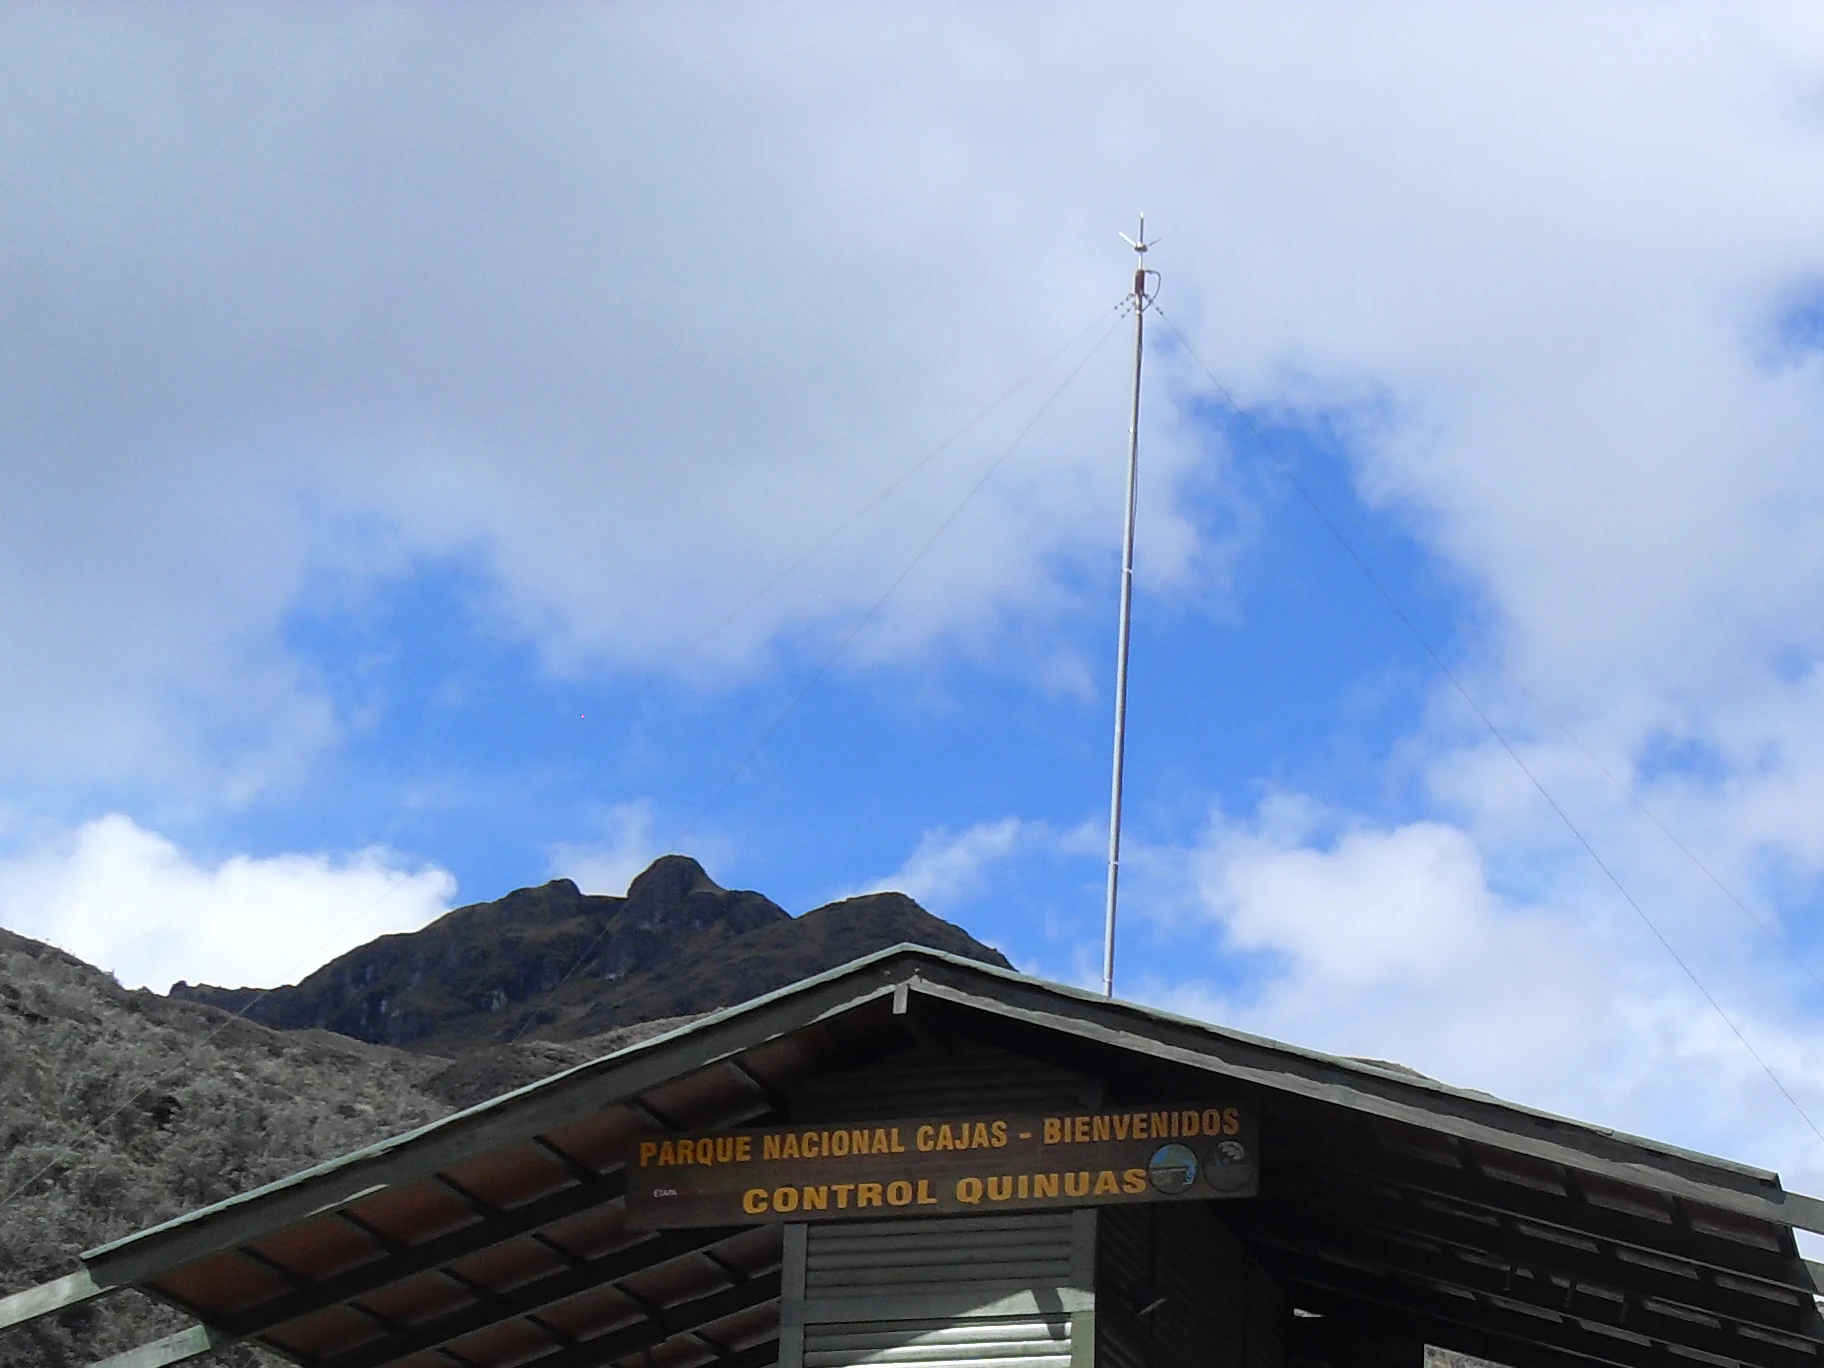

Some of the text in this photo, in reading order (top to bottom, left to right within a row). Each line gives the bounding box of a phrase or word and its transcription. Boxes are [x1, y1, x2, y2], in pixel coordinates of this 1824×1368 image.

[639, 1135, 751, 1168] PARQUE
[763, 1127, 905, 1160] NACIONAL
[917, 1119, 1008, 1153] CAJAS
[1043, 1106, 1240, 1146] BIENVENIDOS
[742, 1167, 1148, 1215] CONTROL QUINUAS
